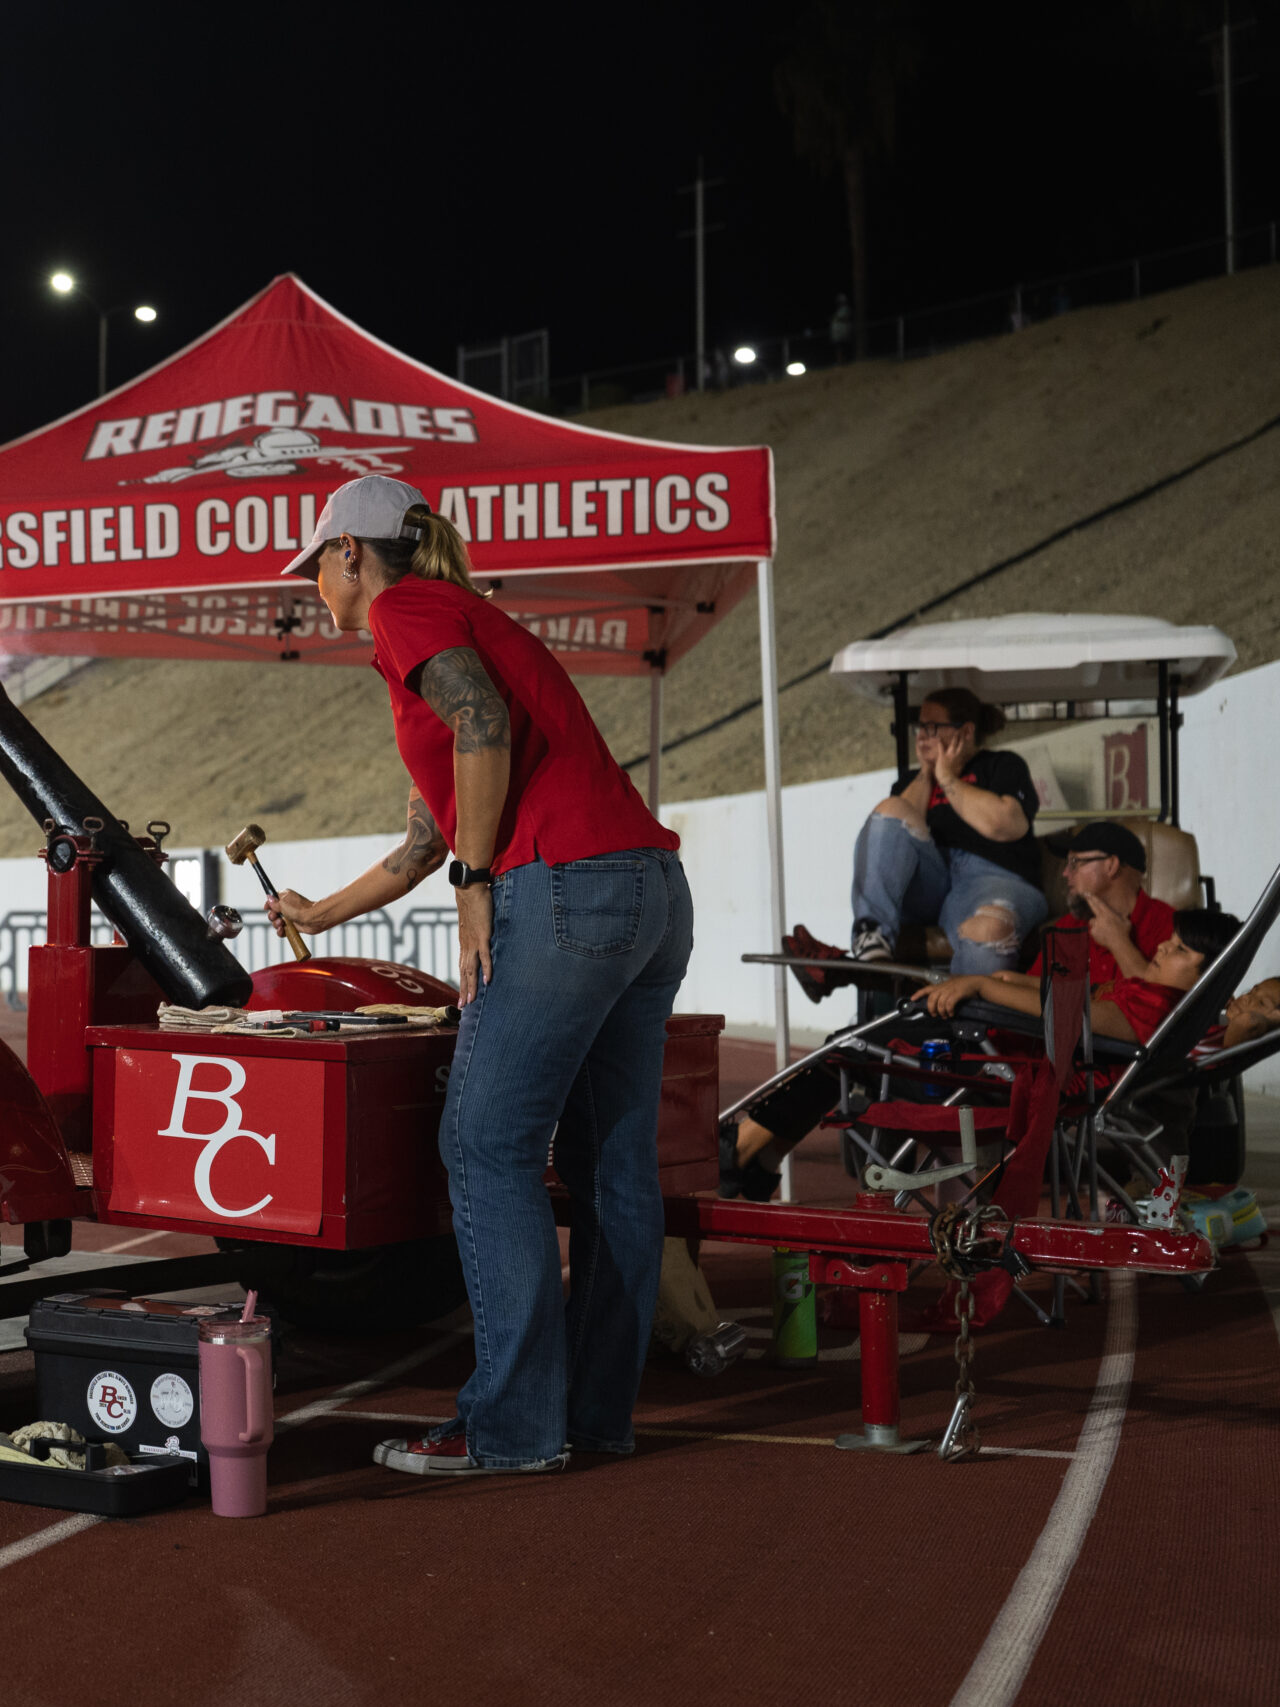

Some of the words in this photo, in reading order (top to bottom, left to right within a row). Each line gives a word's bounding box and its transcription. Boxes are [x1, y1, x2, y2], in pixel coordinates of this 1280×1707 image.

[83, 391, 480, 461] RENEGADES
[195, 494, 318, 556] COLL
[438, 472, 730, 543] ATHLETICS
[158, 1054, 276, 1218] BC
[99, 1385, 124, 1418] BC
